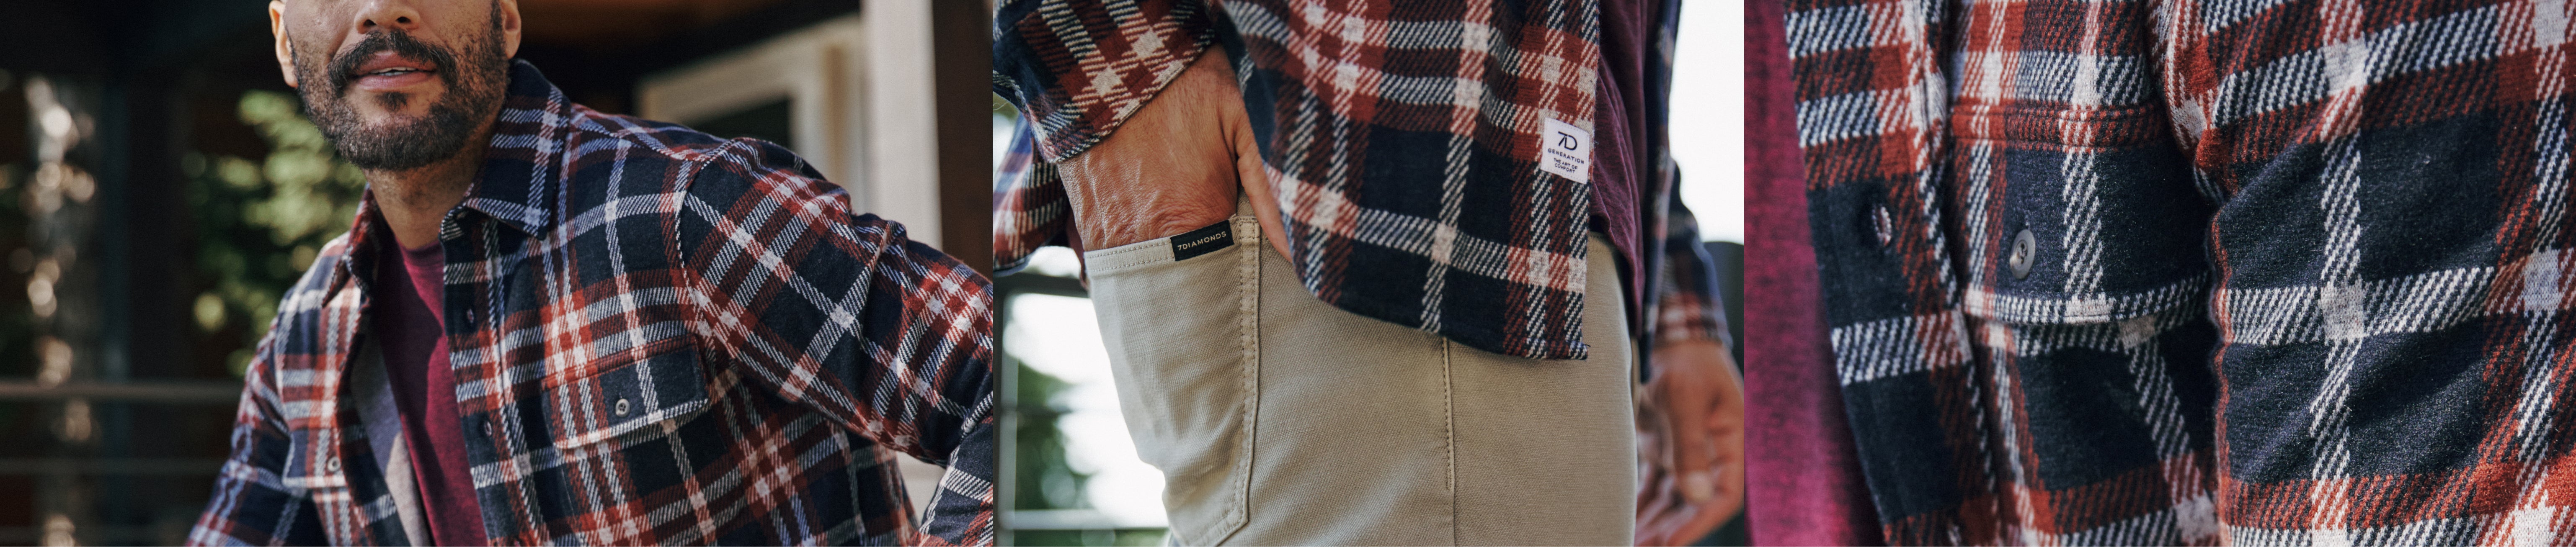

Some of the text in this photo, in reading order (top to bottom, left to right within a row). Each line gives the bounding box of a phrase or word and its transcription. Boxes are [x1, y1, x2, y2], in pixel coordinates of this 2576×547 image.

[1558, 131, 1577, 151] 7D
[1548, 148, 1584, 164] GENERATION
[1555, 163, 1575, 173] COMFORT
[1177, 231, 1226, 251] 7DIAMONDS
